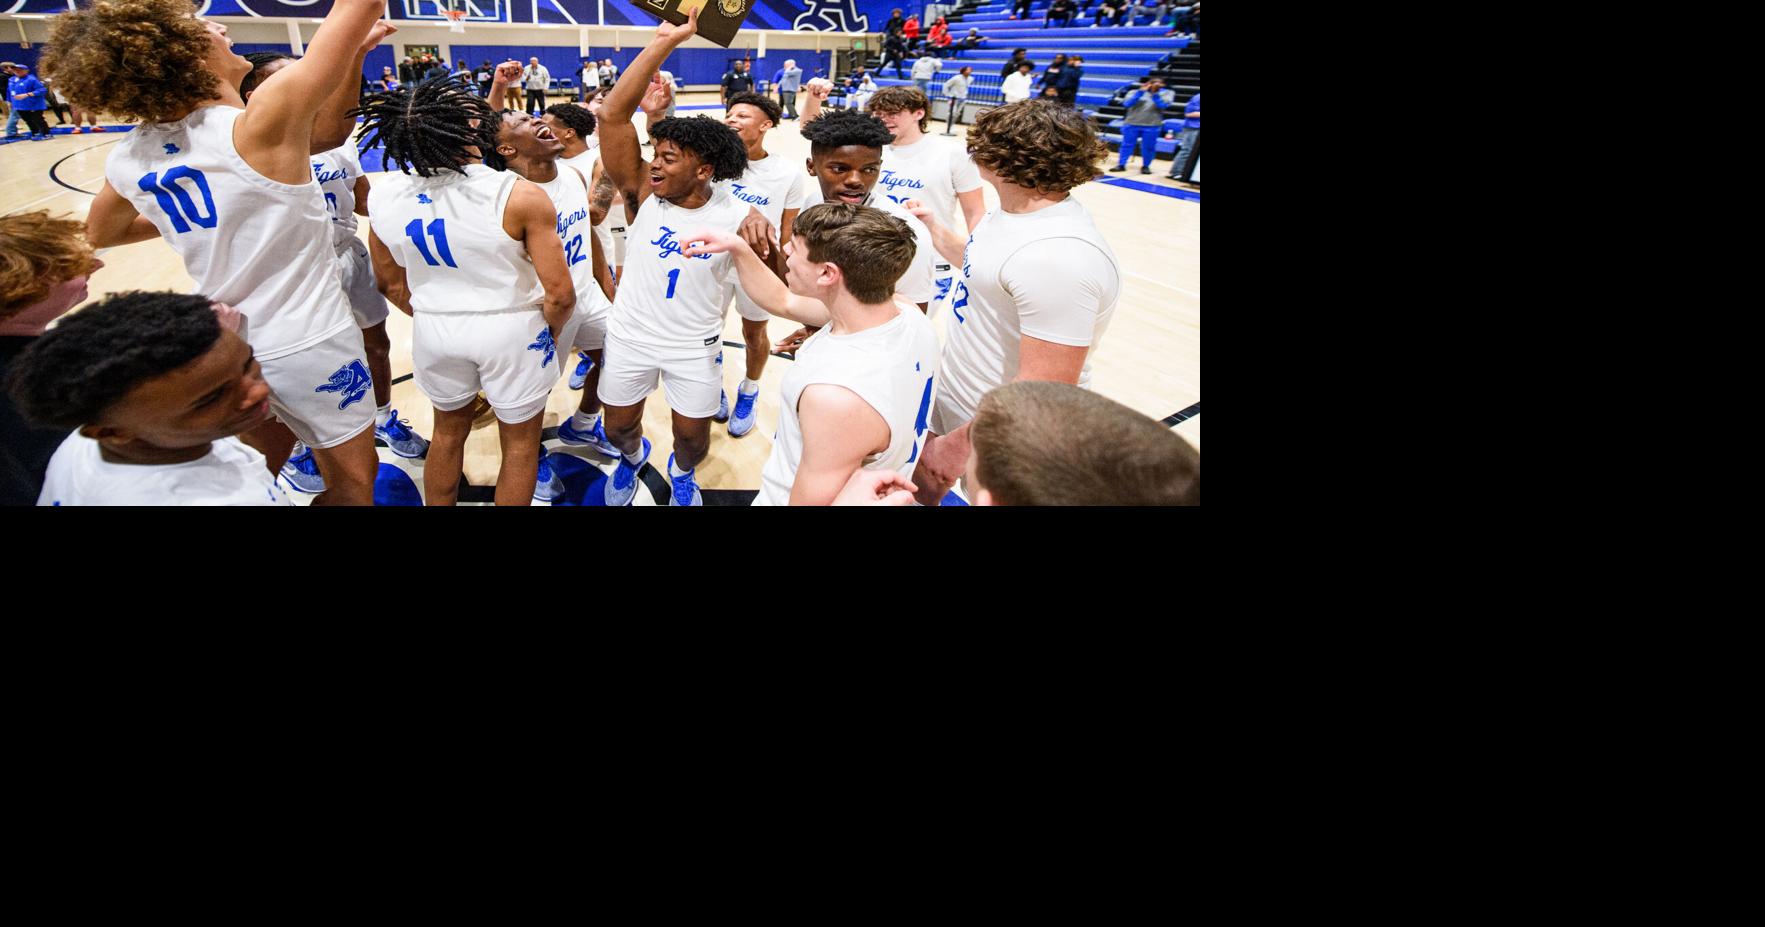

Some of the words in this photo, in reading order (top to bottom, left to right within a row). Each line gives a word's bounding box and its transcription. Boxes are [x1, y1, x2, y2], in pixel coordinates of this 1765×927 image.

[313, 163, 349, 184] Tiges
[879, 170, 924, 191] Tigers
[138, 165, 217, 233] 10
[557, 208, 587, 239] Tigers
[405, 218, 458, 268] 11
[564, 234, 587, 267] 12
[650, 226, 712, 260] Tig
[665, 268, 680, 299] 1
